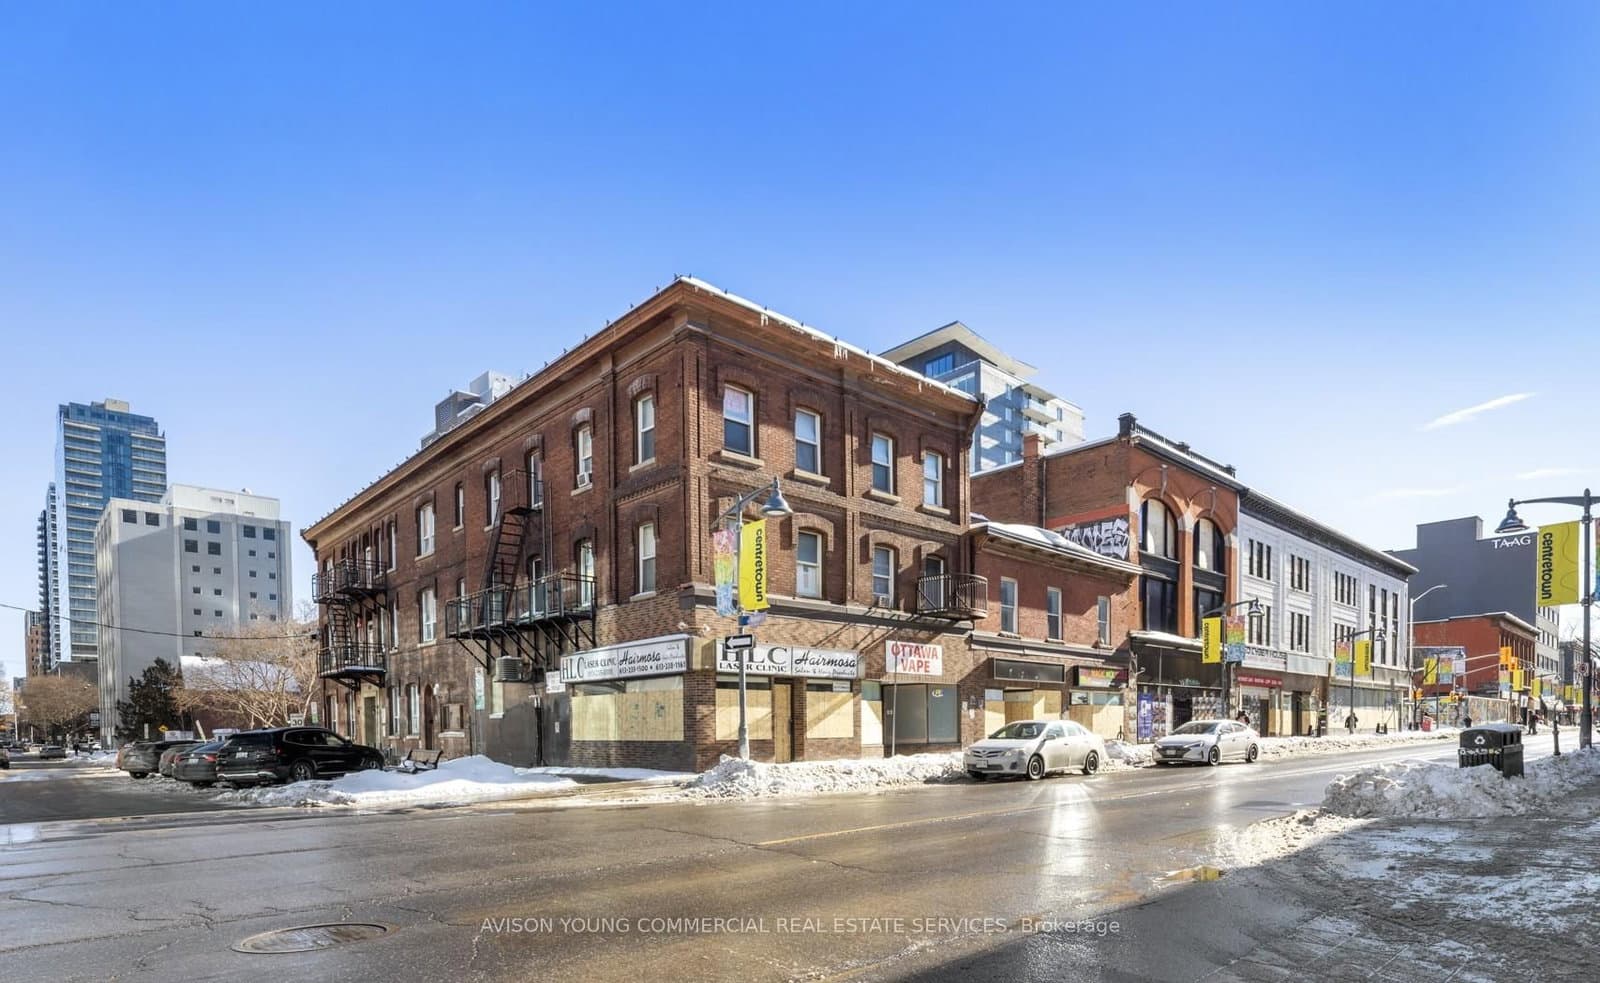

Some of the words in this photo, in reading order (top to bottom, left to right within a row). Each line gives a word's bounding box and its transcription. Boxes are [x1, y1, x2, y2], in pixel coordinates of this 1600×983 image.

[755, 528, 764, 602] centretown
[1541, 532, 1553, 600] centretown
[619, 649, 661, 666] Hairmosa
[794, 650, 857, 667] Hairmosa
[891, 643, 939, 660] OTTAWA
[719, 662, 753, 672] LASR
[756, 664, 787, 673] CLINIC
[901, 660, 931, 673] VAPE
